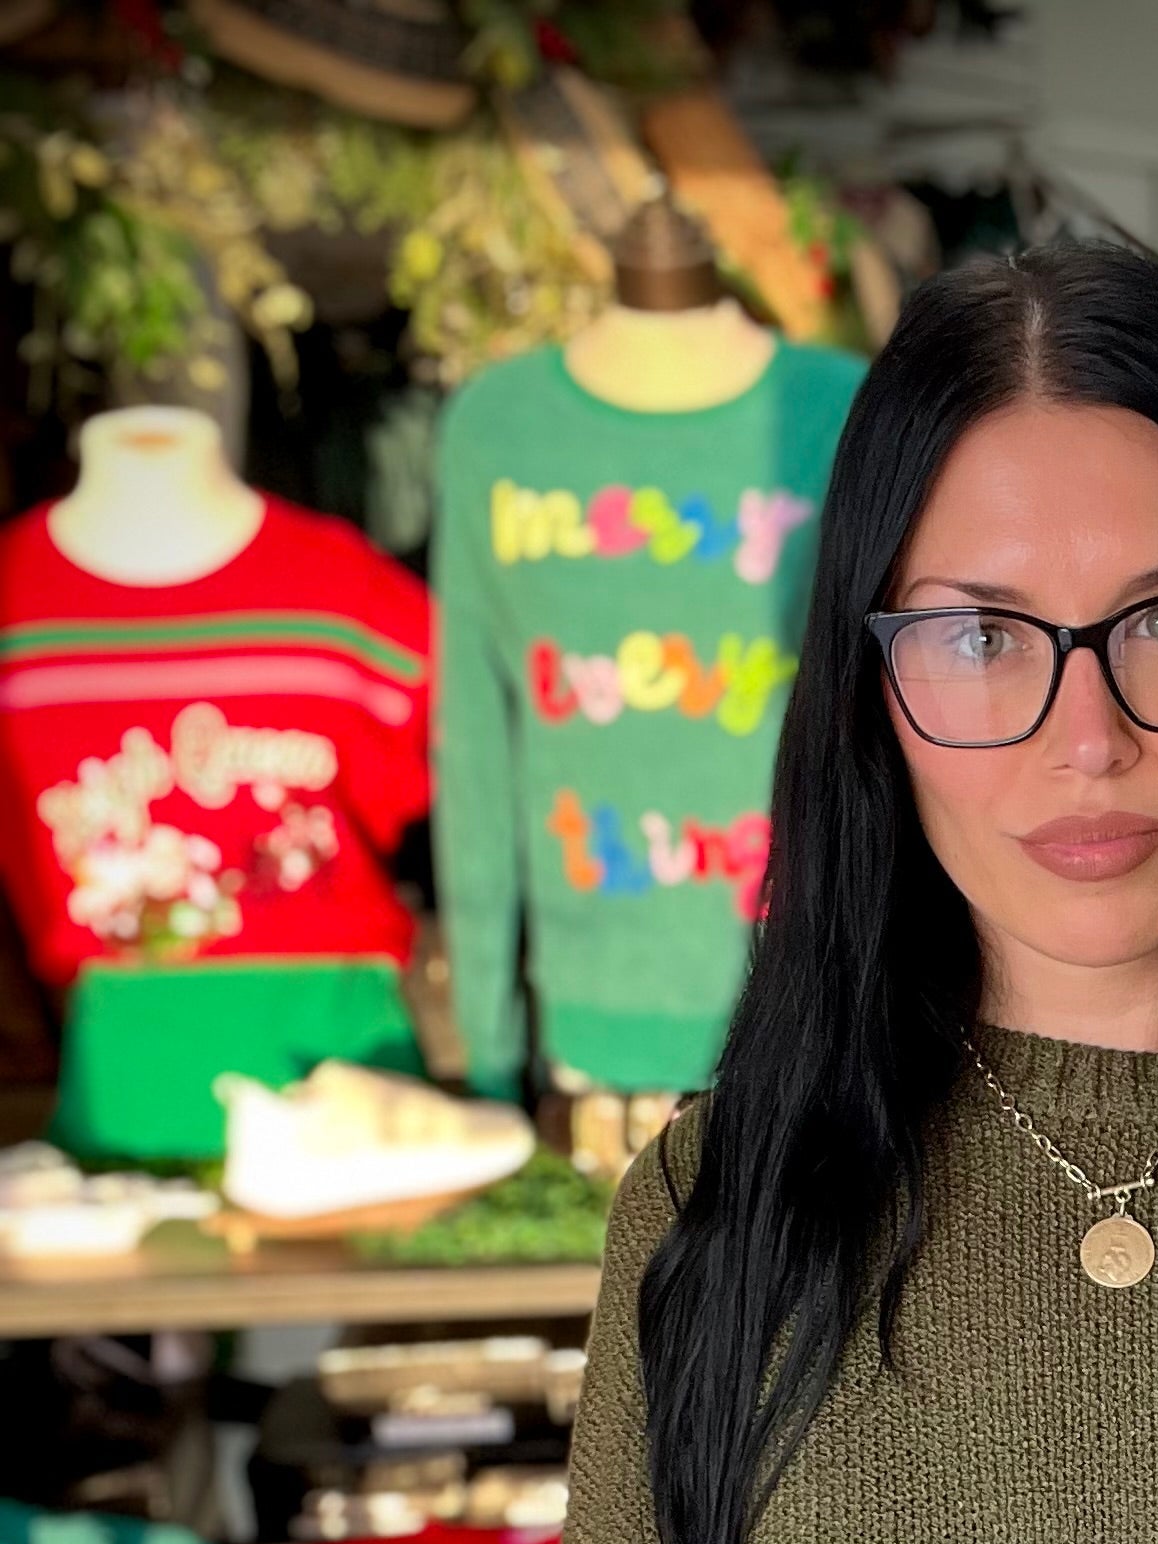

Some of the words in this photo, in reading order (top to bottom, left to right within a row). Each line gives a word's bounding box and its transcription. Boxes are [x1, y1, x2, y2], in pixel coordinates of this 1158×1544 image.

[491, 477, 813, 584] merry
[527, 631, 798, 736] every
[546, 788, 772, 921] thing
